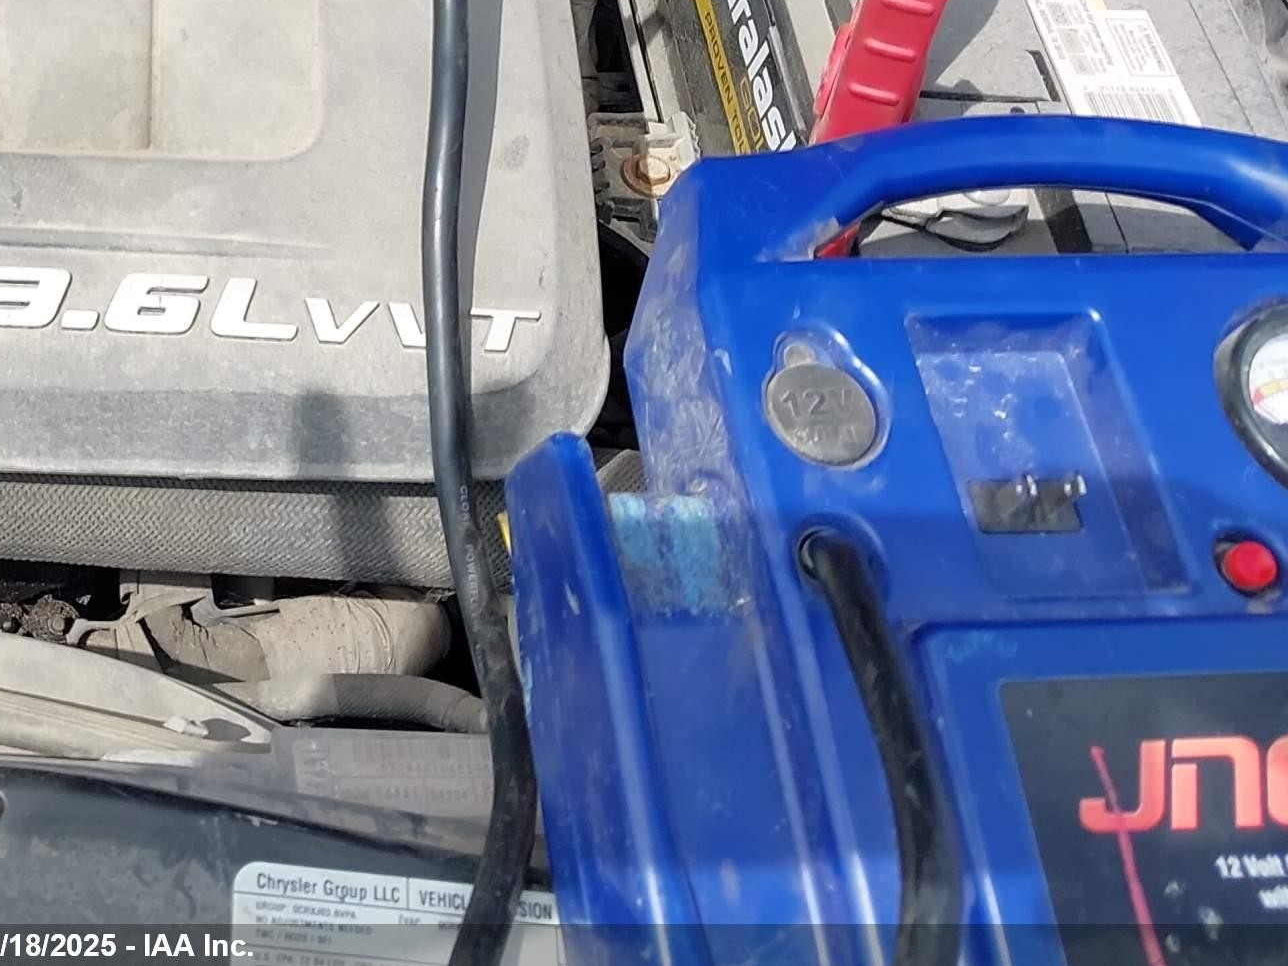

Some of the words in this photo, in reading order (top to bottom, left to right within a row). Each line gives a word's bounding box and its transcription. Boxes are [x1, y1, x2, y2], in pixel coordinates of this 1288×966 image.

[779, 386, 853, 419] 12V
[1214, 855, 1244, 878] 12
[257, 872, 318, 895] Chrysler
[323, 879, 368, 903] Group
[374, 885, 401, 904] LLC
[418, 889, 469, 912] VEHICL
